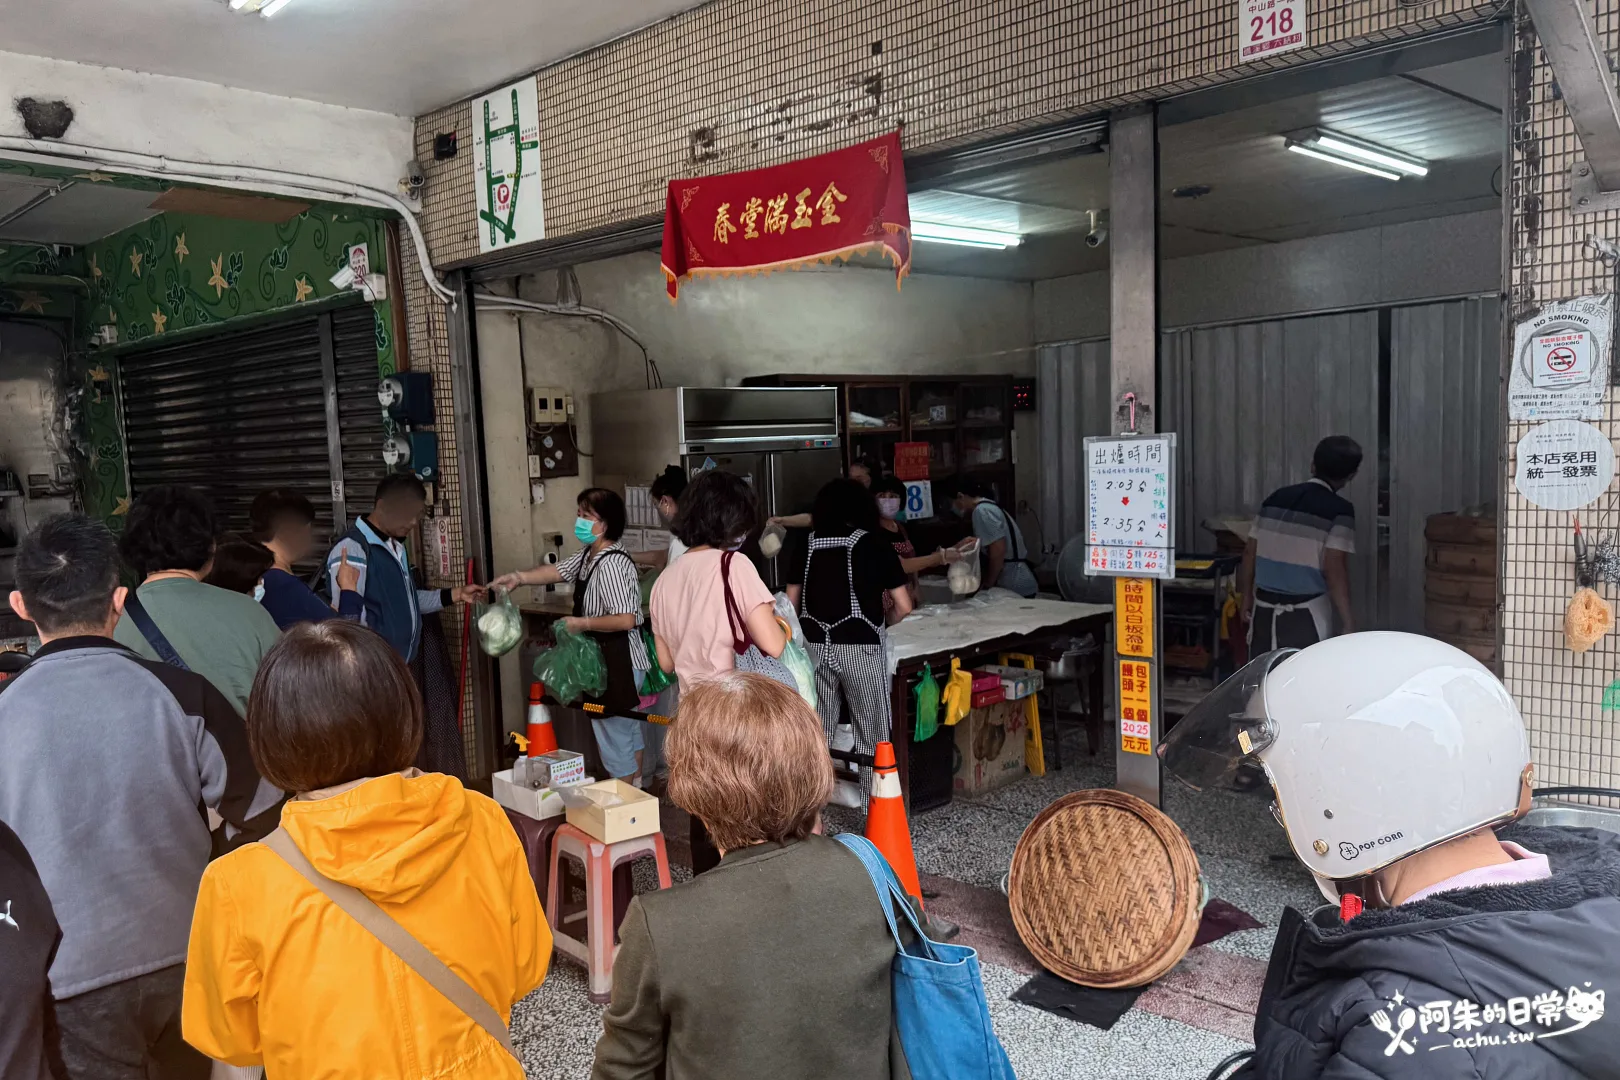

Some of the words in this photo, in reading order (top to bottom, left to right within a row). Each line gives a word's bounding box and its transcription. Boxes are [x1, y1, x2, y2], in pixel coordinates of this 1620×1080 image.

[1250, 7, 1293, 42] 218
[1533, 319, 1546, 329] NO
[1548, 314, 1590, 325] SMOKING
[1094, 443, 1162, 465] 出爐時間
[1526, 450, 1597, 465] 本店免用
[1526, 465, 1598, 480] 統一發票
[907, 485, 924, 512] 8
[1358, 841, 1376, 852] POP
[1377, 831, 1404, 845] CORN
